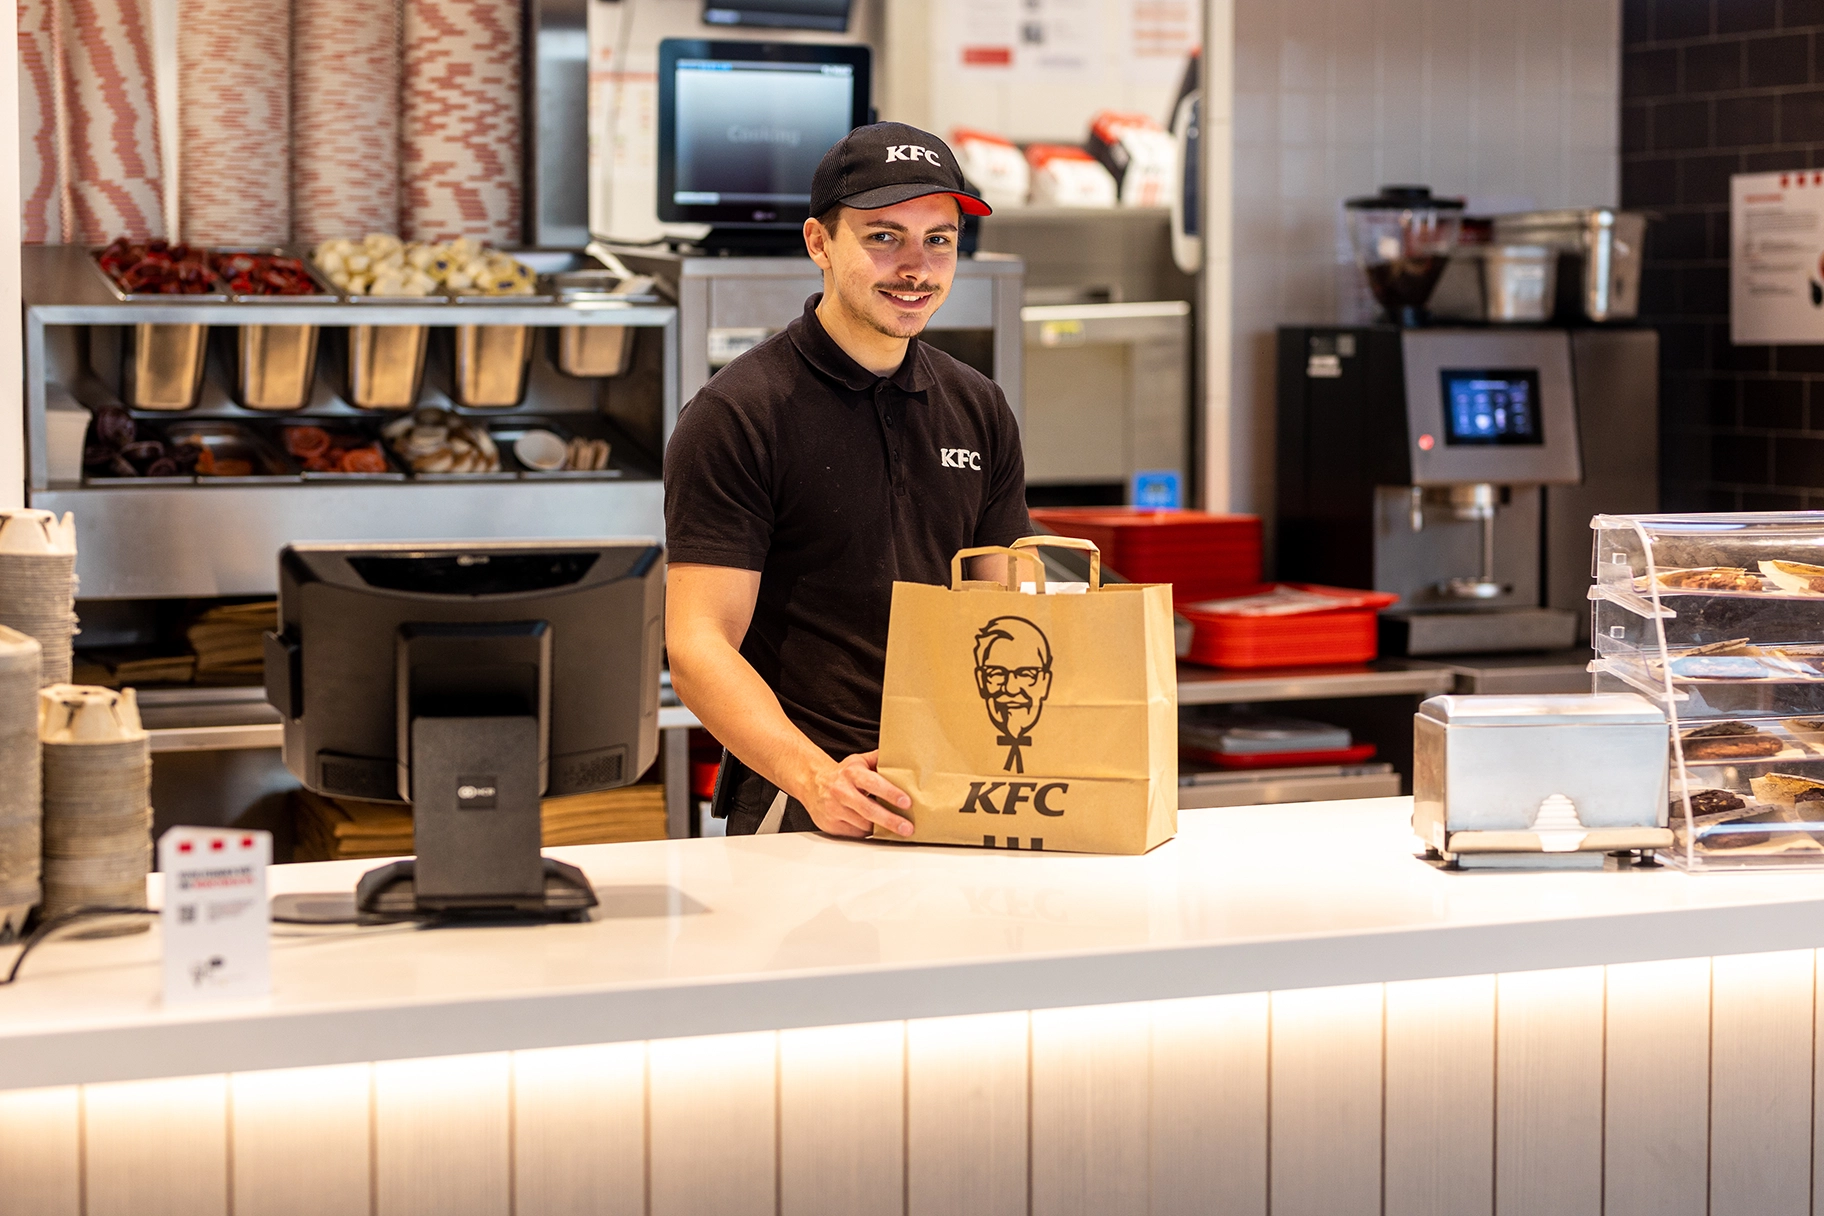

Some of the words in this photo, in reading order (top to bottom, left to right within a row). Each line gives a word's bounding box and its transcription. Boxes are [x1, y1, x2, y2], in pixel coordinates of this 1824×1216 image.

[886, 145, 941, 167] KFC
[940, 448, 981, 471] KFC
[959, 782, 1069, 817] KFC
